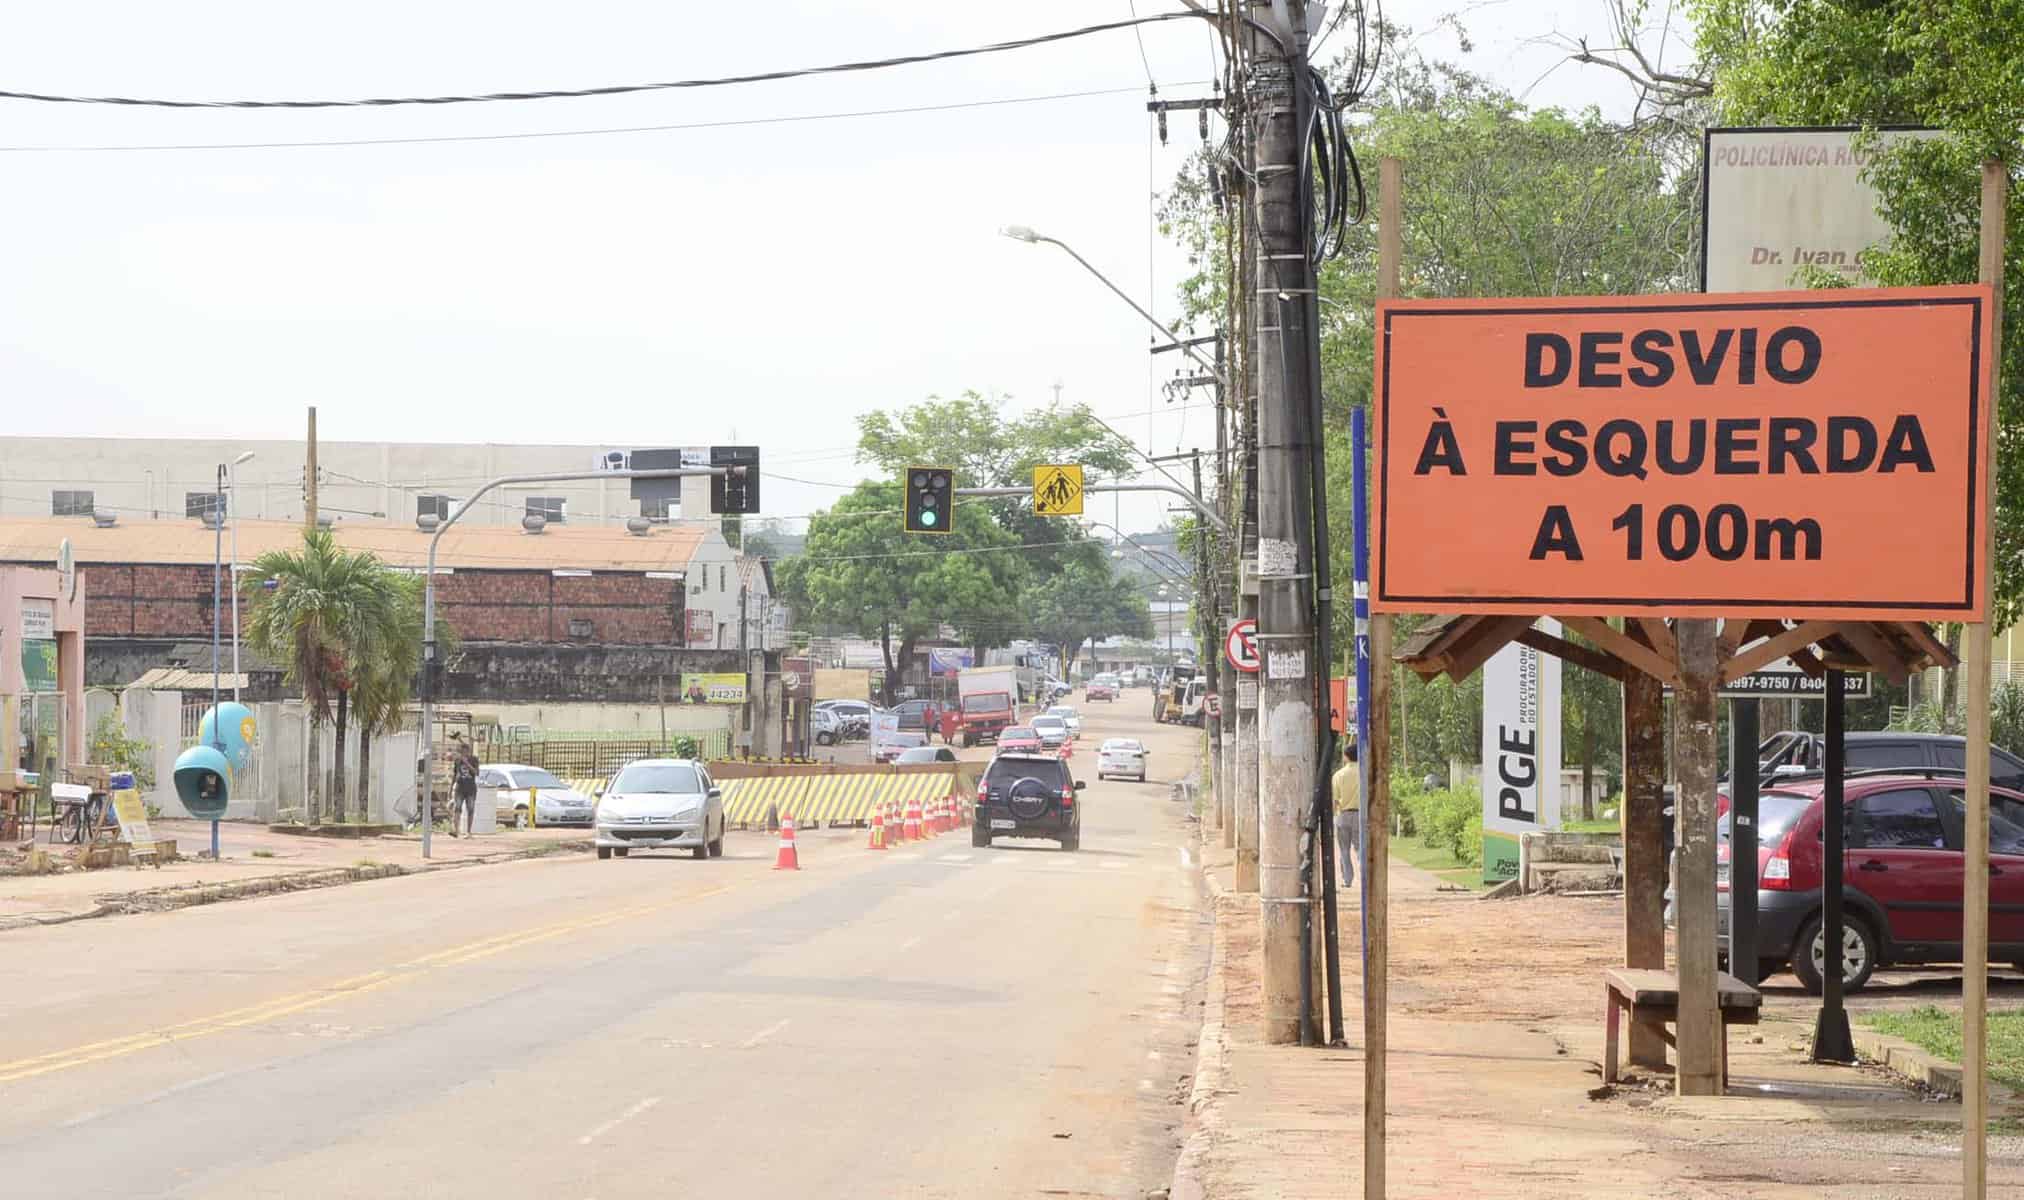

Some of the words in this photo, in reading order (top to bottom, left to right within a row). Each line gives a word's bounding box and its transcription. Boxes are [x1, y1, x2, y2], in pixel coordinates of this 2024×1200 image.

[1714, 141, 1829, 167] POLICLÍNICA
[1751, 247, 1783, 265] Dr.
[1792, 247, 1845, 265] Ivan
[1524, 326, 1822, 388] DESVIO
[1414, 407, 1467, 476] À
[1494, 414, 1935, 480] ESQUERDA
[1529, 505, 1584, 561] A
[1613, 504, 1822, 561] 100m
[1519, 647, 1529, 724] PROCURADORI
[1528, 664, 1536, 706] ESTADO
[1528, 709, 1536, 724] DO
[1499, 725, 1536, 823] PGE
[1496, 859, 1520, 867] Pov
